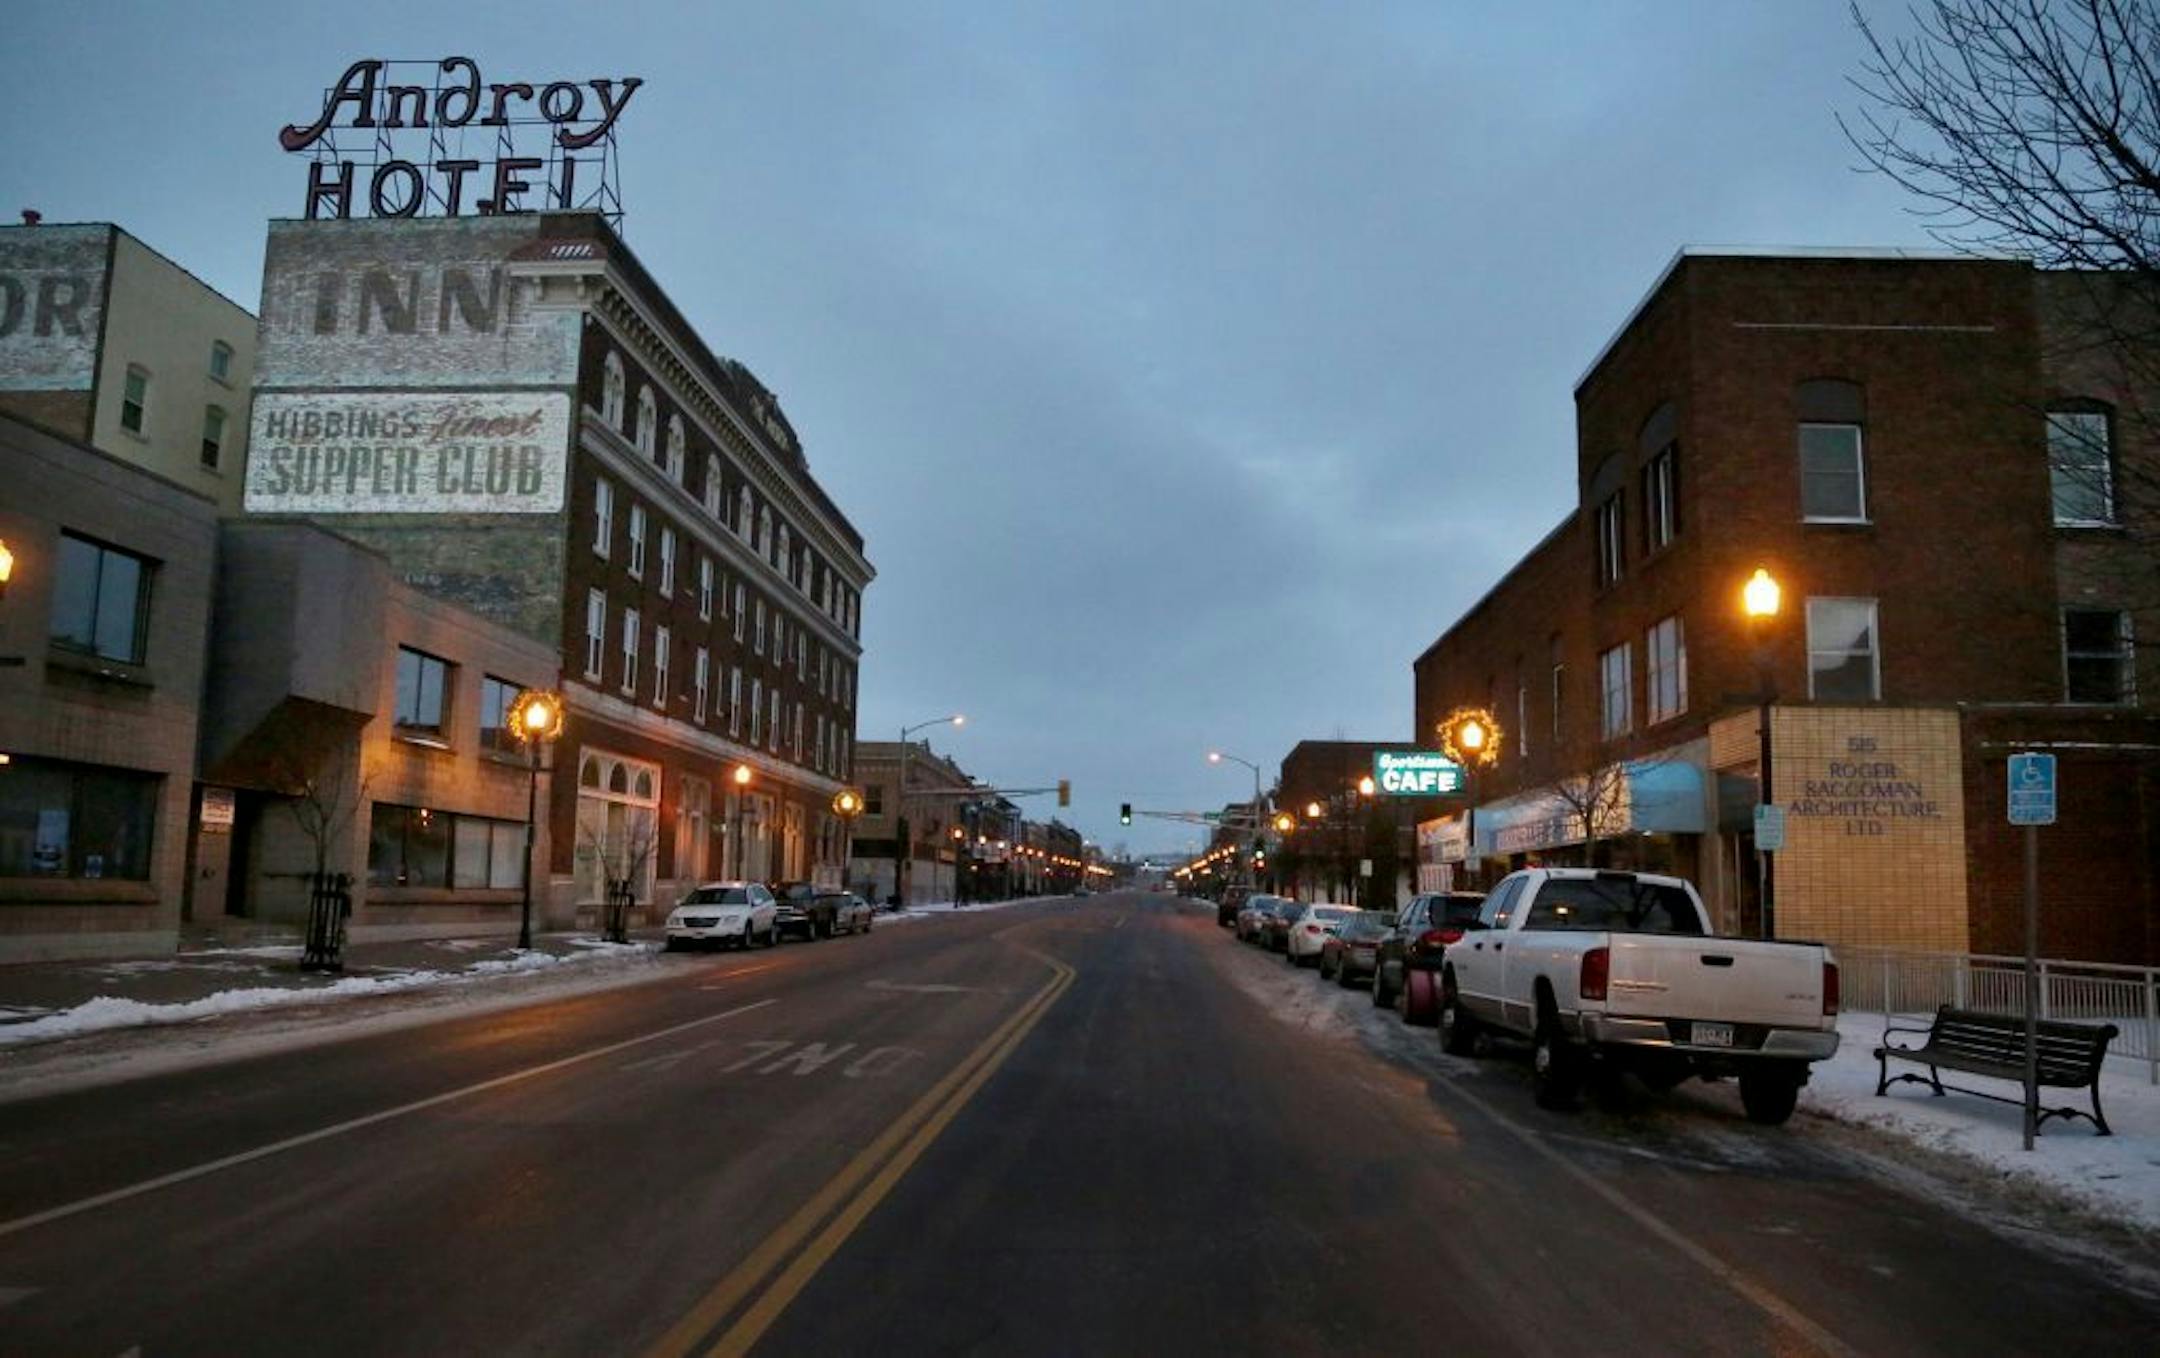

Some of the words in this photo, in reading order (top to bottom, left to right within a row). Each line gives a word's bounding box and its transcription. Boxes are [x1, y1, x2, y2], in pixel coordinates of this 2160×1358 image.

[279, 57, 643, 151] Androy
[314, 268, 504, 335] INN
[265, 409, 422, 440] HIBBINGS
[267, 446, 418, 496] SUPPER
[437, 445, 542, 495] CLUB
[1383, 771, 1456, 792] CAFE
[1830, 762, 1897, 778] ROGER
